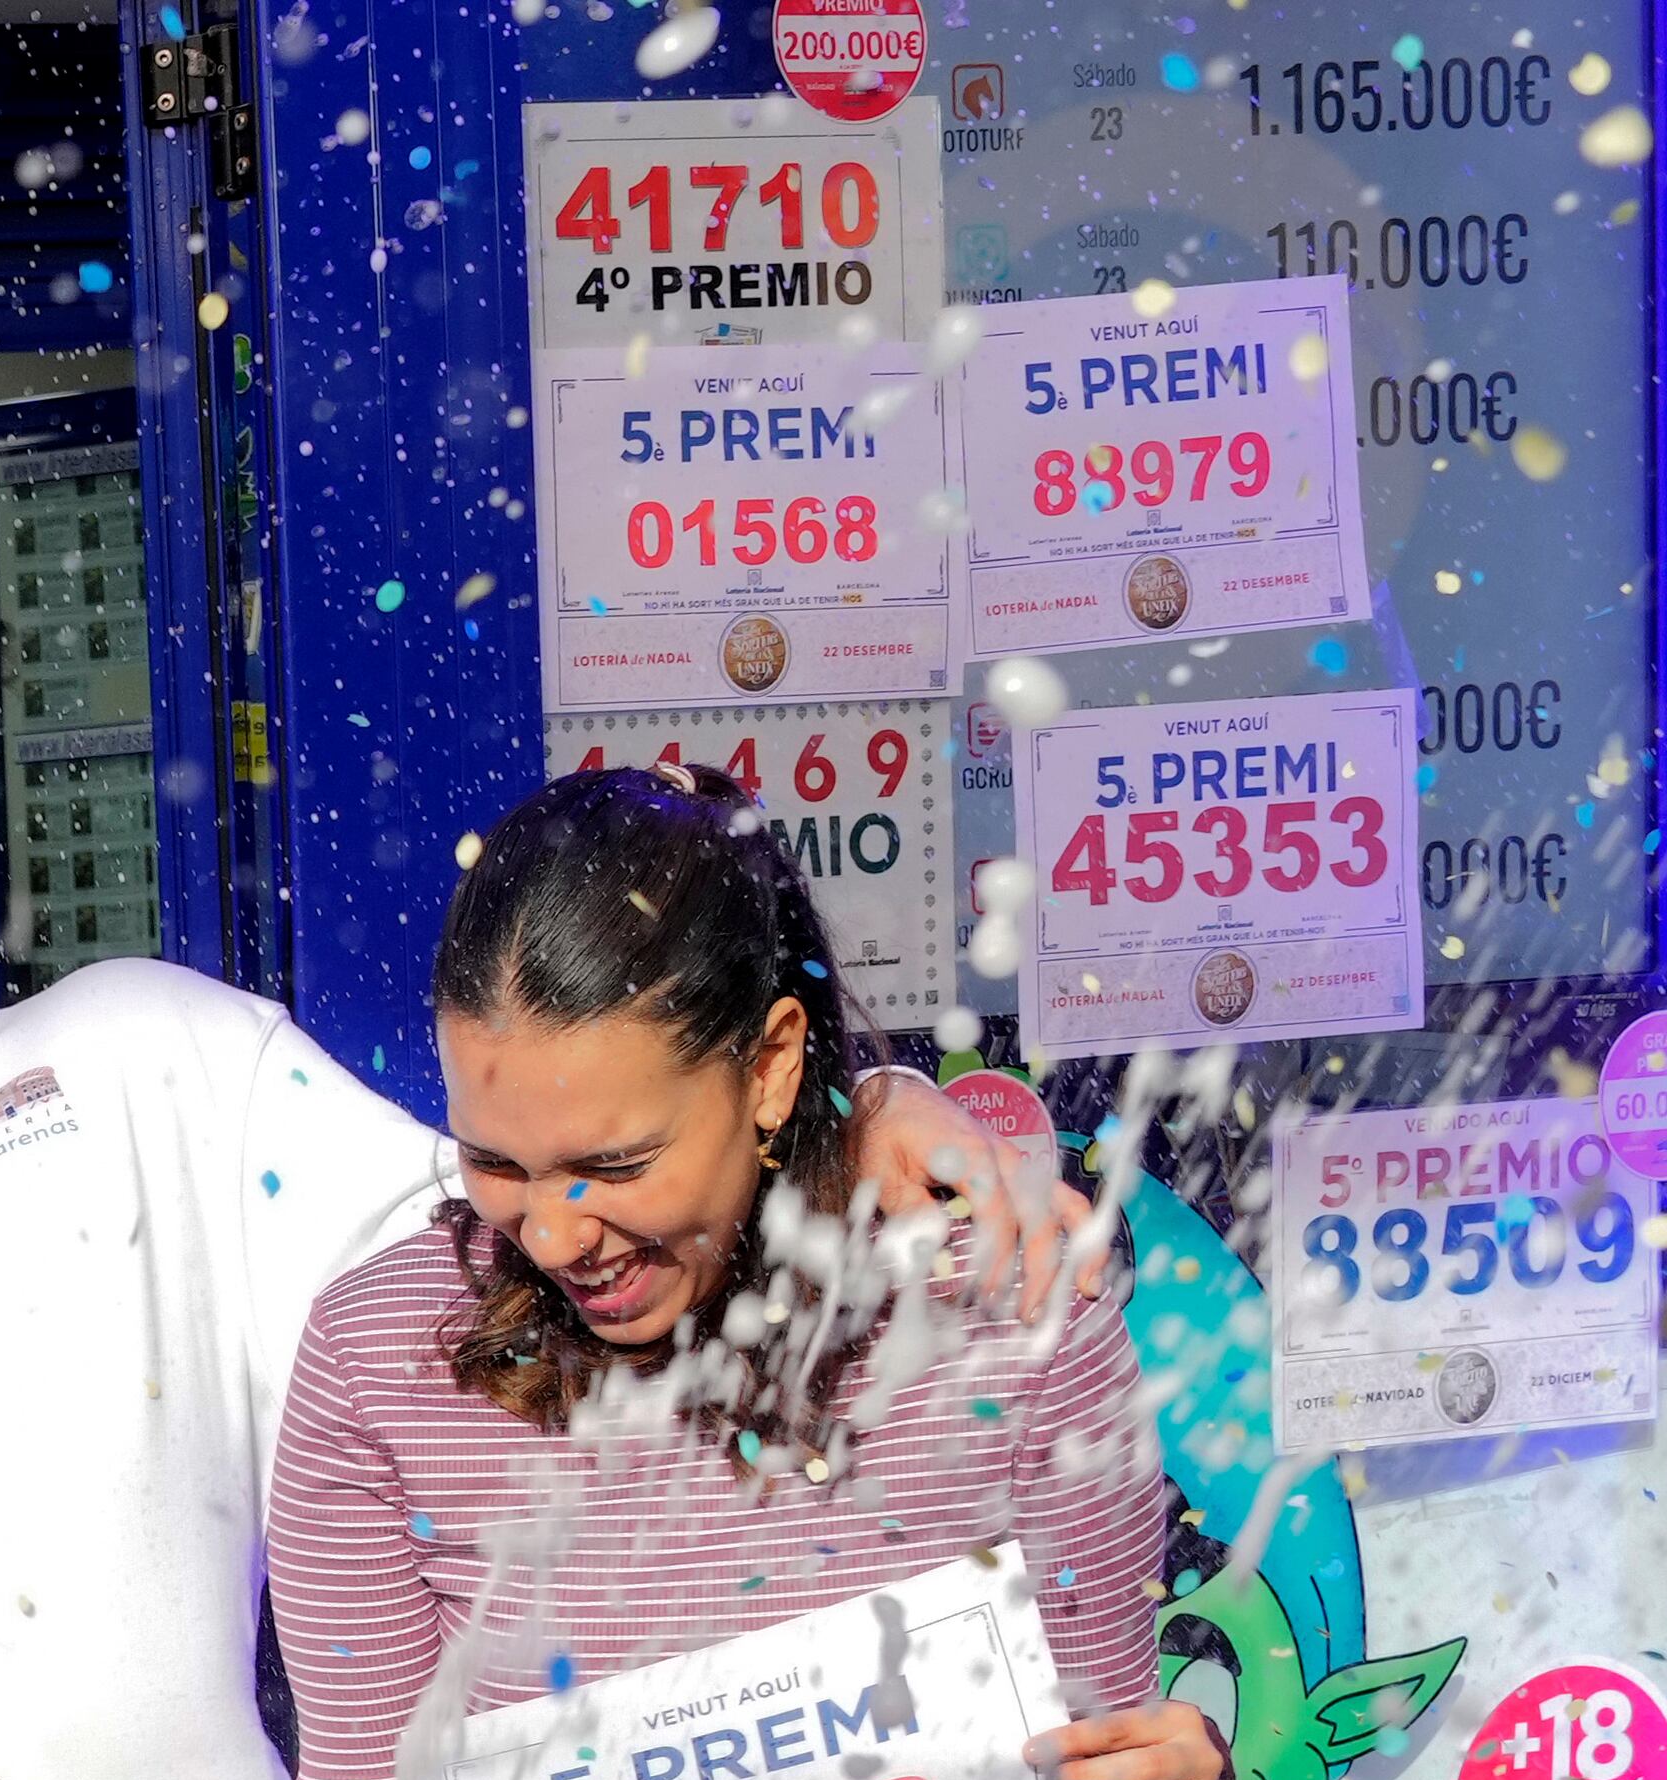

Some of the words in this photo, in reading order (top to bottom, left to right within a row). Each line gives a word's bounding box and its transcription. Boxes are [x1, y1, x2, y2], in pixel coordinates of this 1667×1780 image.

[783, 30, 923, 61] 200.000€
[1073, 63, 1136, 88] Sábado
[1238, 54, 1553, 138] 1.165.000€
[1090, 106, 1123, 142] 23
[555, 161, 880, 255] 41710
[1077, 223, 1140, 250] Sábado
[1266, 213, 1530, 292] 110.000€
[575, 266, 630, 313] 4º
[651, 260, 873, 312] PREMIO
[1093, 264, 1128, 295] 23
[1090, 323, 1148, 342] VENUT
[1155, 314, 1198, 336] AQUÍ
[1025, 362, 1068, 415] 5è
[1080, 343, 1267, 410] PREMI
[620, 411, 664, 463] 5è
[1033, 431, 1271, 516] 88979
[627, 495, 878, 569] 01568
[1223, 581, 1238, 592] 22
[1241, 572, 1310, 590] DESEMBRE
[574, 654, 628, 667] LOTERIA
[630, 654, 645, 665] de
[647, 652, 692, 664] NADAL
[823, 646, 838, 658] 22
[843, 643, 913, 657] DESEMBRE
[1164, 719, 1220, 736] VENUT
[1226, 712, 1269, 732] AQUÍ
[1096, 755, 1137, 808] 5è
[1152, 742, 1337, 804] PREMI
[1051, 796, 1388, 906] 45353
[1376, 1130, 1612, 1200] PREMIO
[1366, 1387, 1425, 1403] NAVIDAD
[643, 1693, 728, 1730] VENUT
[738, 1666, 801, 1706] AQUÍ
